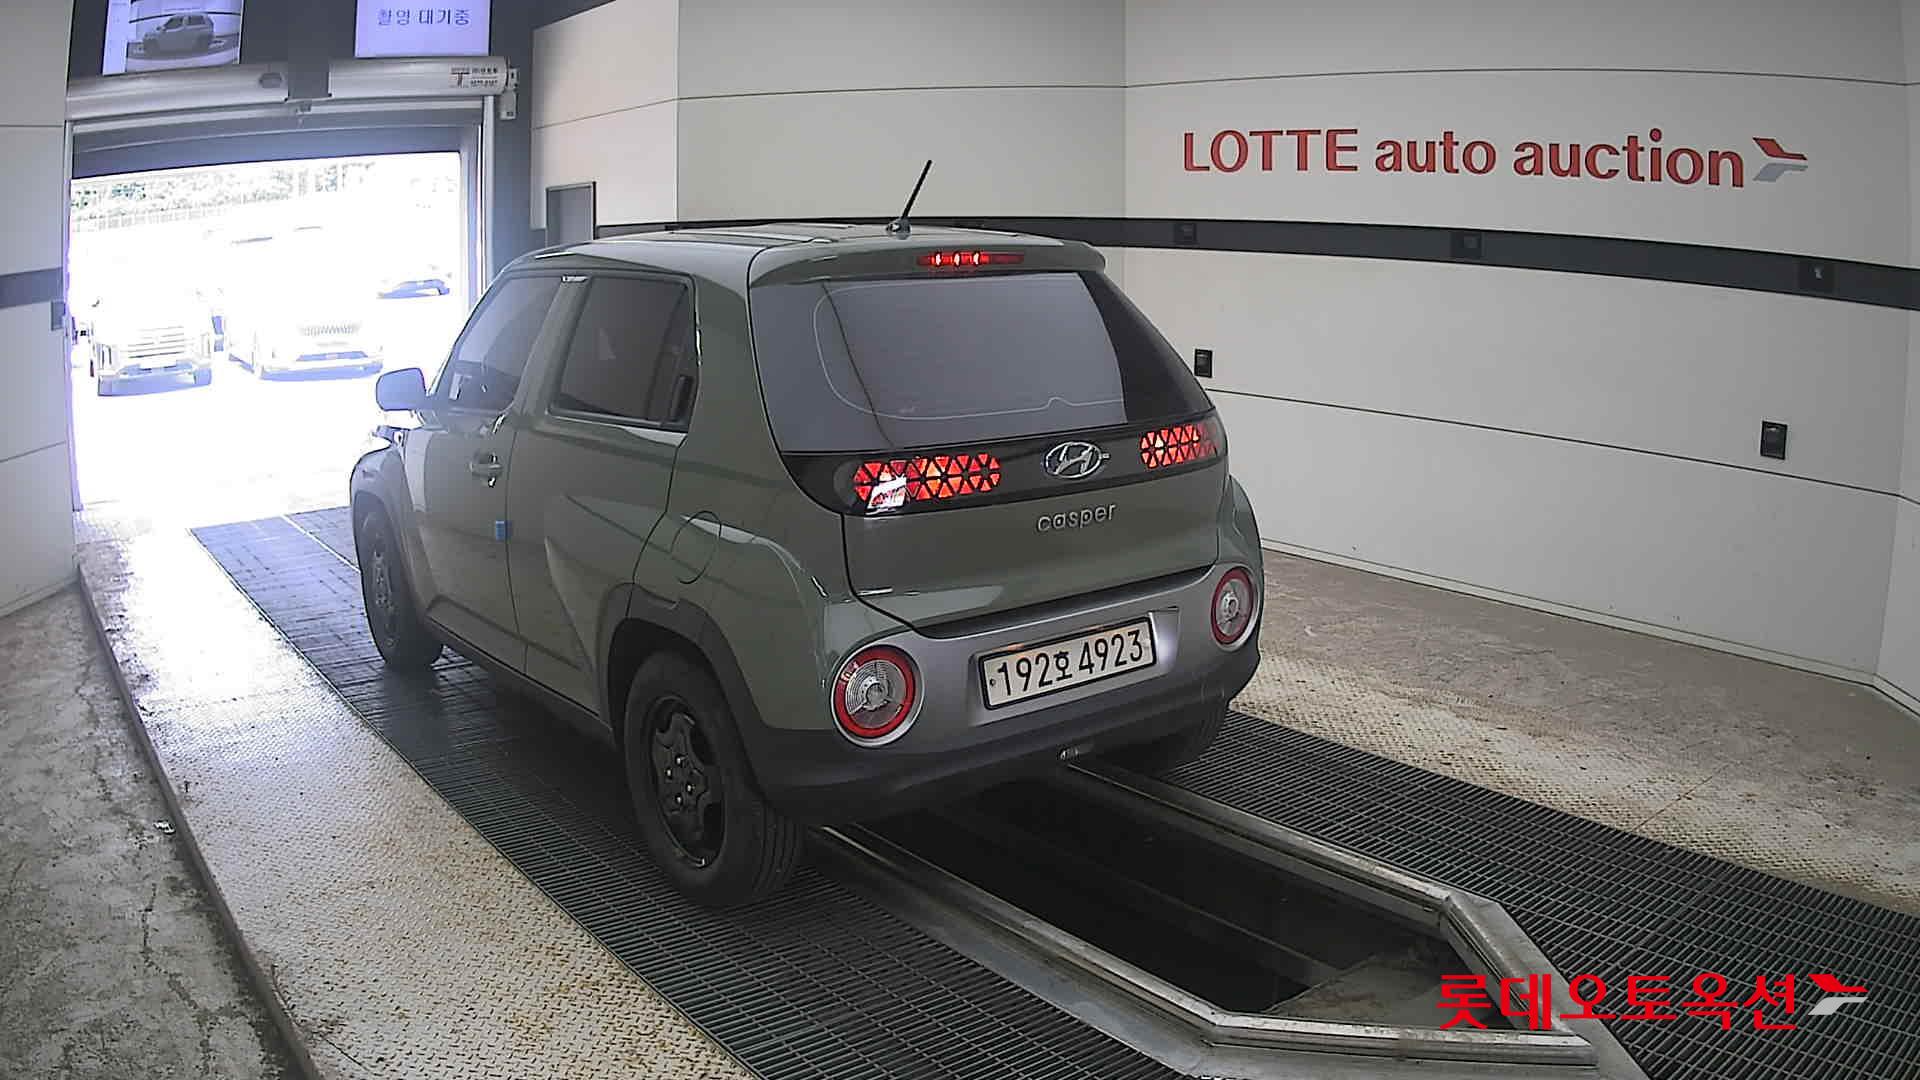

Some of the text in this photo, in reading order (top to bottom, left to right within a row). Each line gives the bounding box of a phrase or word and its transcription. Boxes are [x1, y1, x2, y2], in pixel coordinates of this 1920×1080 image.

[419, 8, 469, 26] 대기중
[1183, 128, 1744, 188] LOTTE auto auction
[1037, 504, 1116, 532] casper
[997, 629, 1143, 696] 192호 4923
